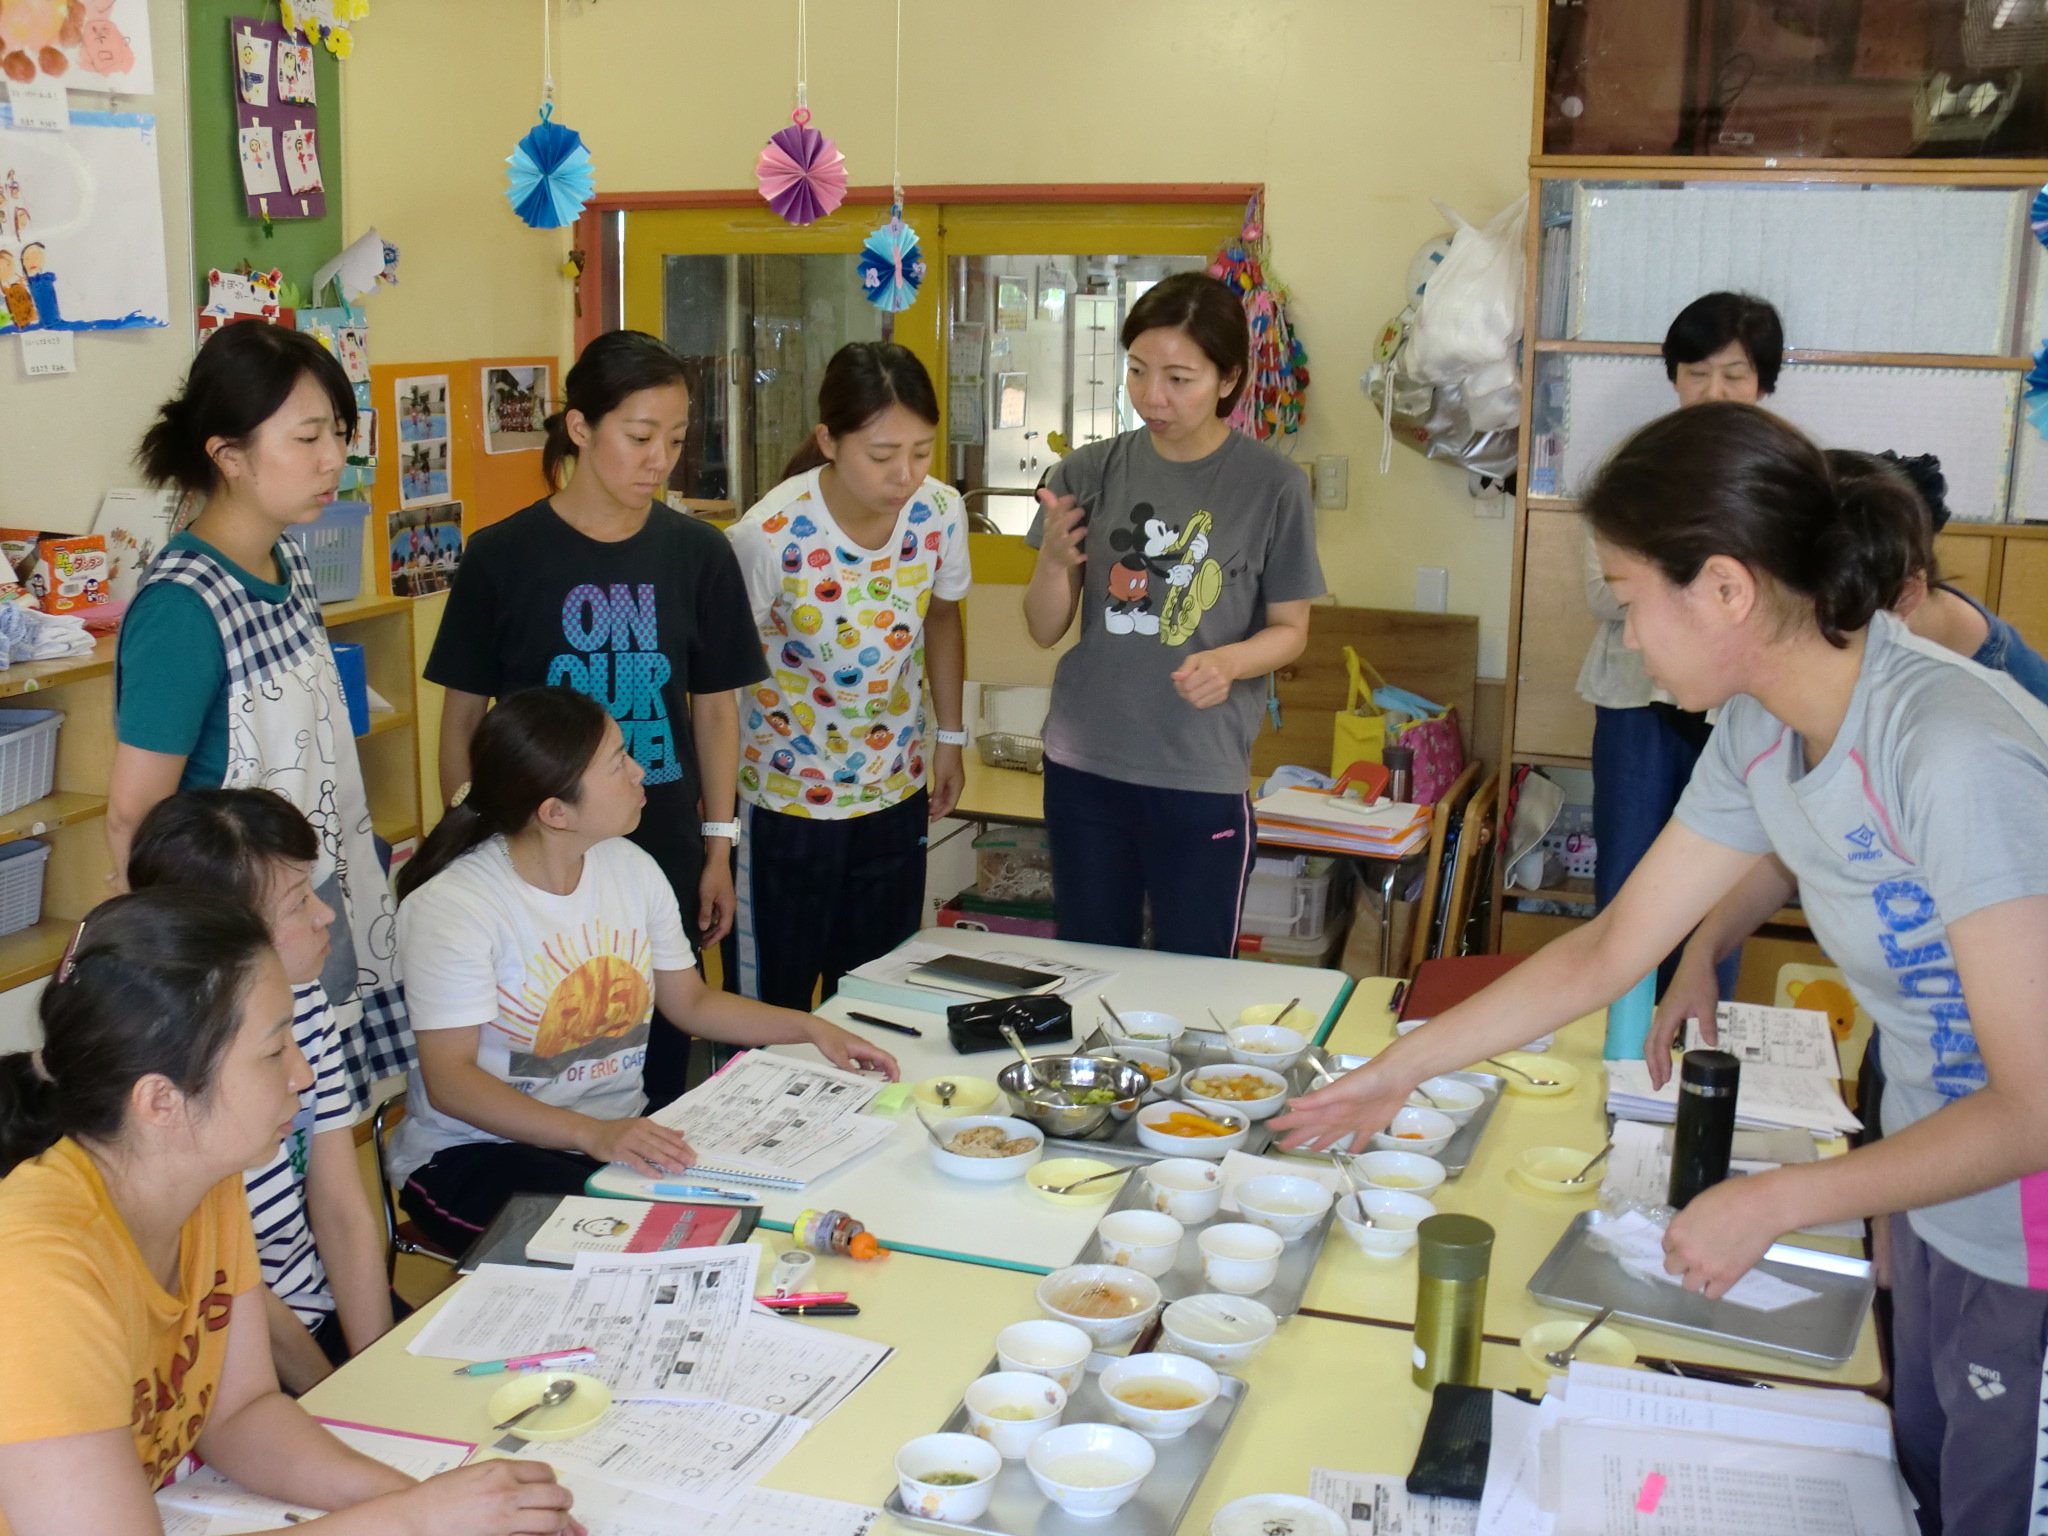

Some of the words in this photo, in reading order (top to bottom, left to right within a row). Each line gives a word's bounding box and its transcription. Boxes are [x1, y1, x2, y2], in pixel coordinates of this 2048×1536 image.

[561, 583, 658, 652] ON
[1847, 848, 1884, 862] umbro
[567, 1066, 586, 1081] OF
[590, 1058, 619, 1080] ERIC
